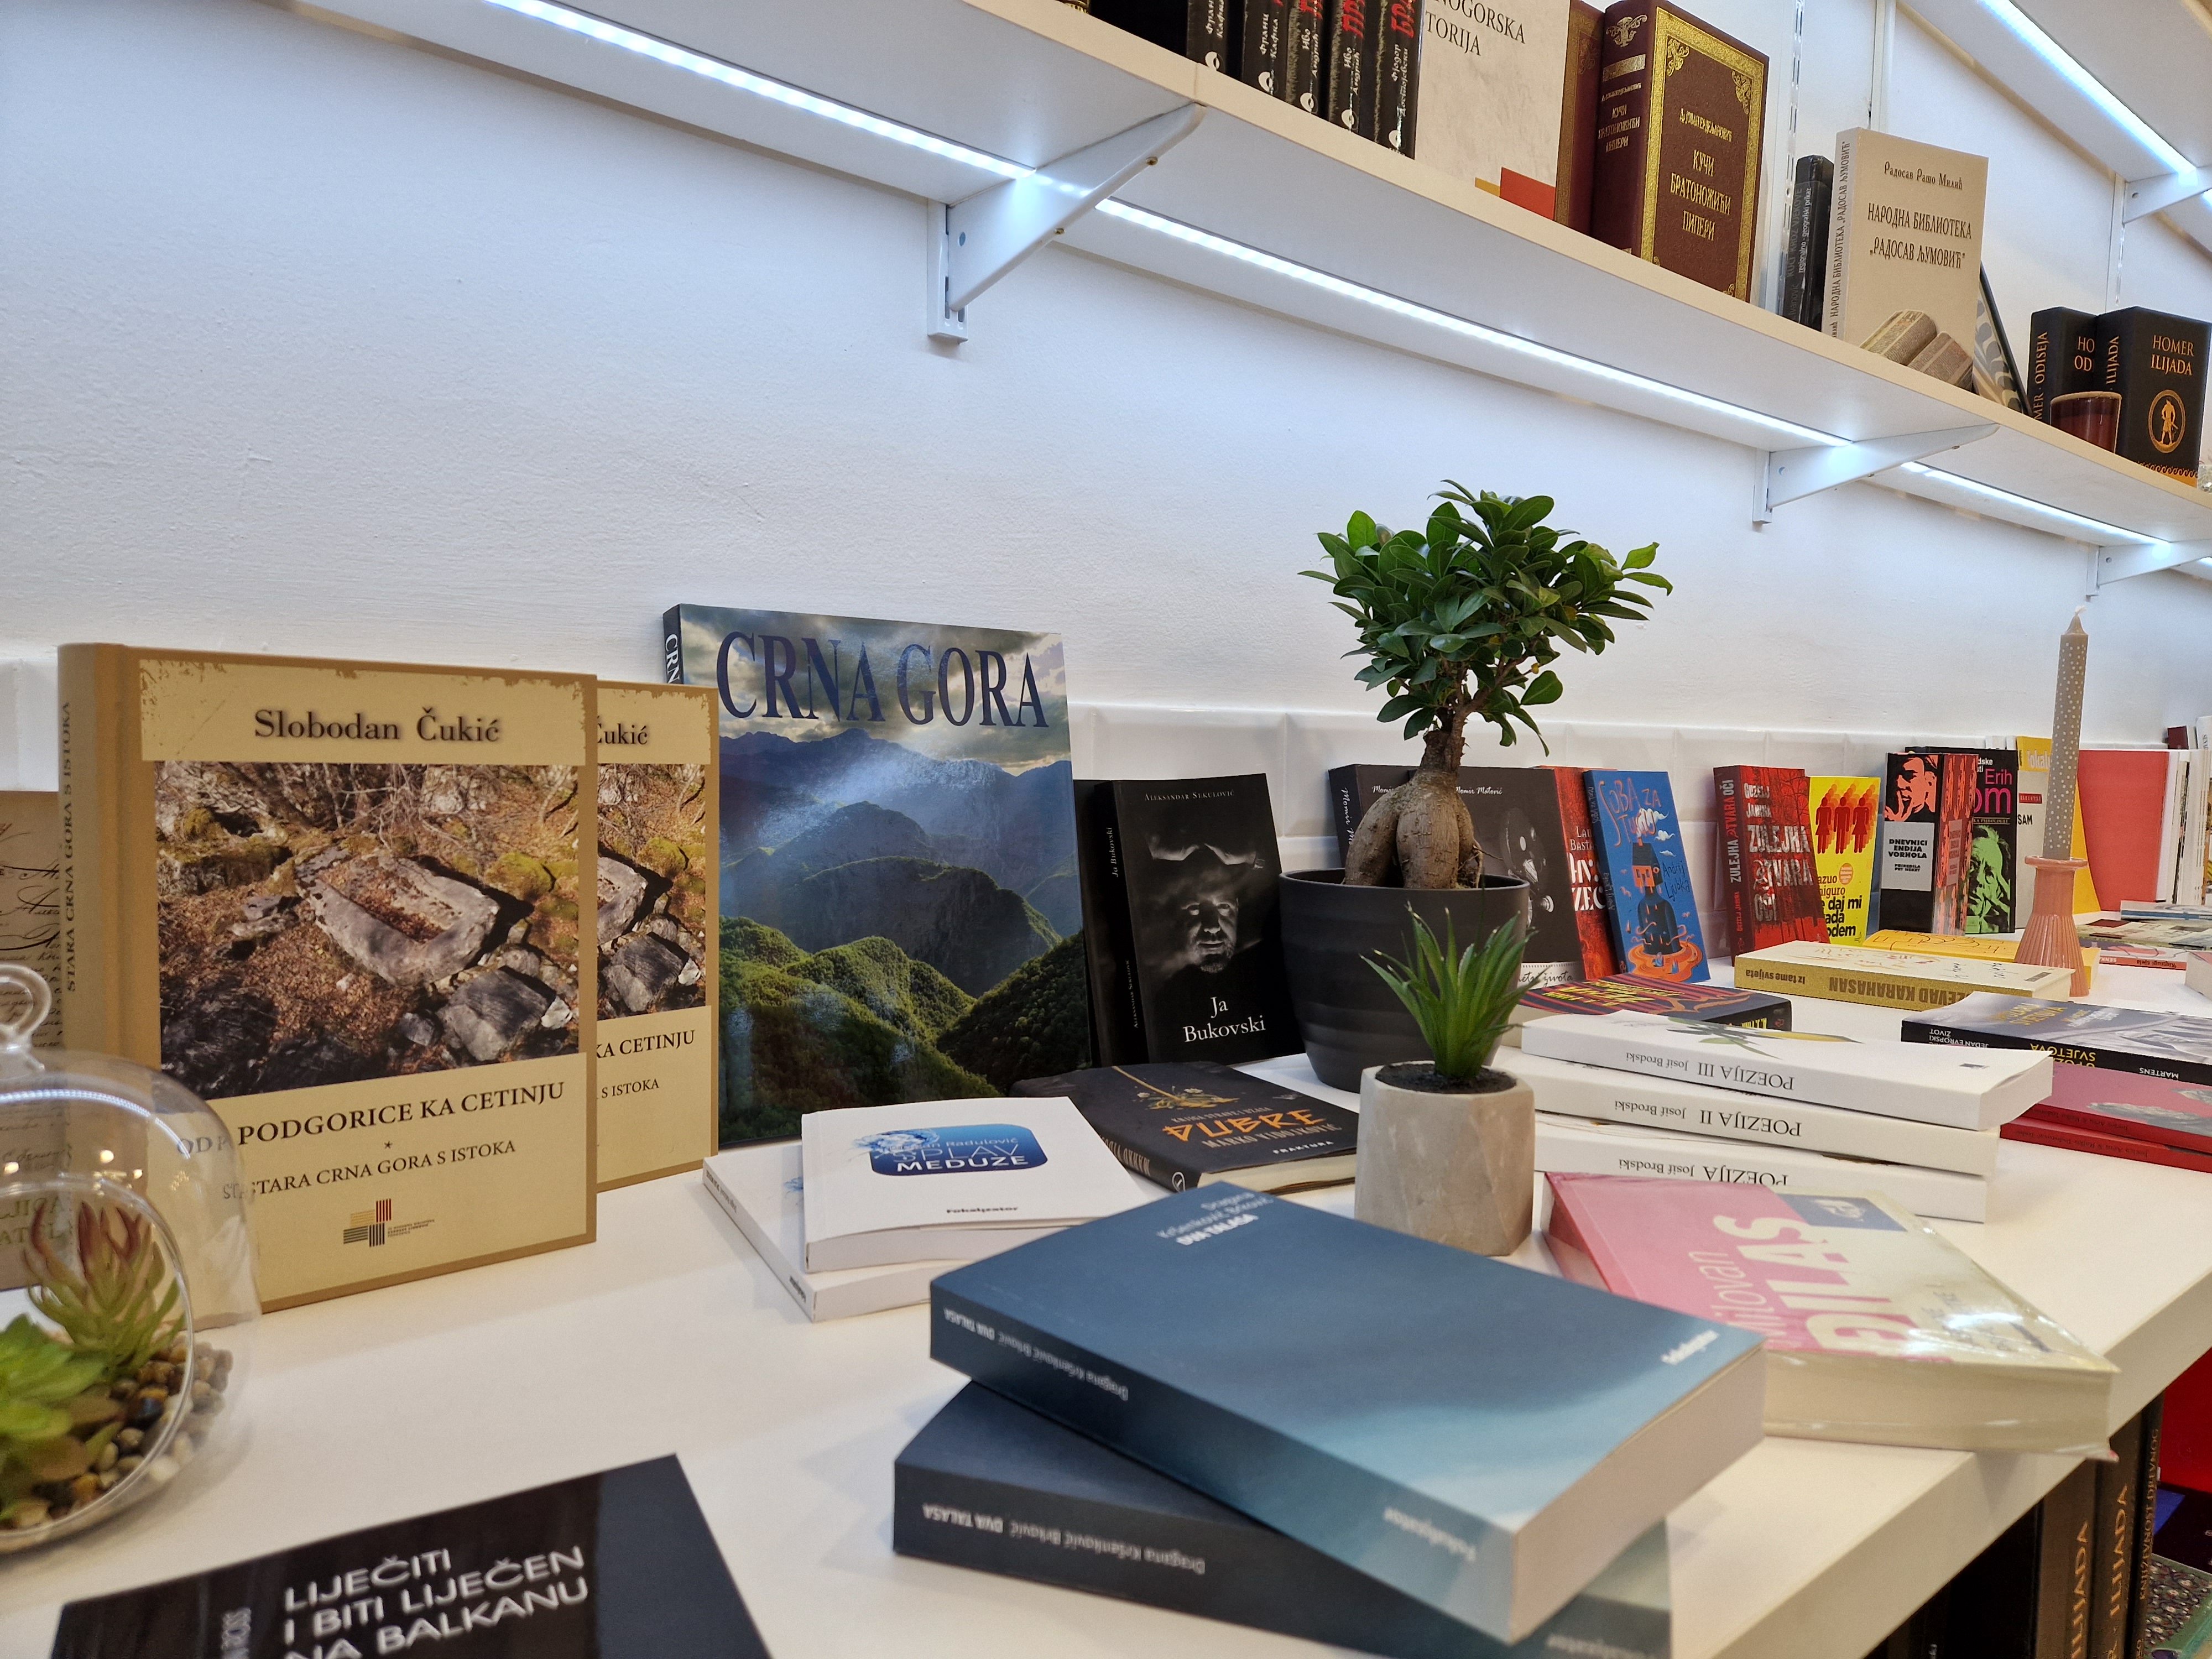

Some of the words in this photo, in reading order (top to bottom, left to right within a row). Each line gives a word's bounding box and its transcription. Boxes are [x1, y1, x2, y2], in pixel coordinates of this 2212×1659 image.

[1205, 0, 1215, 34] Фран
[1434, 0, 1526, 44] OGORSKA
[1259, 13, 1270, 55] Франц
[1270, 18, 1279, 59] Кафка
[1301, 28, 1311, 50] Иво
[1311, 33, 1320, 79] Андрић
[1343, 46, 1353, 69] Иво
[1391, 44, 1402, 81] Фјодор
[1693, 149, 1714, 178] КУЧИ
[1884, 161, 1913, 180] Радосав
[1916, 168, 1936, 185] Рашо
[1938, 173, 1963, 191] Милић
[1670, 173, 1732, 216] БРАТОНОЖИЋИ
[1682, 210, 1715, 241] ПИПЕРИ
[1867, 202, 1911, 228] НАРОДНА
[1913, 214, 1972, 240] БИБЛИОТЕКА
[1797, 241, 1807, 274] regionalno
[1802, 206, 1811, 237] geografski
[1834, 226, 1845, 279] БИБЛИОТЕКА
[1830, 280, 1841, 319] НАРОДНА
[2035, 332, 2048, 383] ODISEJA
[2152, 335, 2194, 357] HOMER
[2106, 336, 2120, 384] ILIJADA
[2151, 354, 2193, 376] ILIJADA
[2034, 395, 2044, 421] MER
[664, 633, 681, 684] CRN
[716, 630, 886, 722] CRNA
[896, 643, 1049, 728] GORA
[254, 709, 400, 742] Slobodan
[416, 707, 501, 742] Čukić
[61, 702, 71, 777] ISTOKA
[1723, 779, 1734, 796] OČI
[1985, 768, 2013, 785] Erih
[63, 784, 72, 796] S
[1372, 785, 1395, 794] Momi
[1641, 788, 1662, 808] ZA
[62, 818, 74, 860] GORA
[1106, 827, 1118, 865] Bukovski
[1747, 825, 1812, 853] ZULEJHA
[1727, 839, 1742, 883] ZULEJHA
[1888, 851, 1928, 859] VORHOLA
[1112, 865, 1119, 878] Ja
[1662, 860, 1686, 875] Andrij
[1818, 875, 1838, 884] azuo
[64, 875, 76, 921] CRNA
[1664, 878, 1691, 901] Ljubka
[1828, 896, 1845, 912] daj
[1848, 895, 1863, 909] mi
[1825, 910, 1845, 924] ada
[64, 940, 76, 993] STARA
[1745, 969, 1774, 982] svijeta
[1775, 973, 1796, 983] tame
[1796, 975, 1806, 984] Iz
[1829, 976, 1916, 1001] KARAHASAN
[1211, 996, 1229, 1019] Ja
[1182, 1015, 1267, 1042] Bukovski
[1929, 1029, 1952, 1039] ŽIVOT
[619, 1030, 696, 1056] CETINJU
[1929, 1035, 1964, 1047] EVROPSKI
[1965, 1040, 1989, 1048] JEDAN
[1626, 1052, 1664, 1068] Brodski
[1666, 1057, 1689, 1072] Josif
[1698, 1062, 1715, 1078] III
[1720, 1065, 1795, 1091] POEZIJA
[2139, 1067, 2179, 1079] MARTENS
[601, 1087, 608, 1098] S
[611, 1078, 660, 1097] ISTOKA
[238, 1103, 414, 1146] PODGORICE
[420, 1099, 455, 1119] KA
[461, 1081, 566, 1113] CETINJU
[1614, 1100, 1658, 1115] Brodski
[1660, 1105, 1686, 1120] Josif
[1699, 1109, 1712, 1125] II
[1162, 1108, 1327, 1142] ĐUBRE
[1719, 1112, 1802, 1138] POEZIJA
[893, 1144, 1019, 1163] SPLAV
[946, 1138, 1019, 1147] Radulović
[1202, 1135, 1255, 1149] MARKO
[1273, 1140, 1334, 1155] FRAKTURA
[316, 1164, 372, 1185] CRNA
[377, 1152, 433, 1173] GORA
[437, 1150, 446, 1165] S
[451, 1140, 516, 1162] ISTOKA
[896, 1155, 1029, 1172] MEDUZE
[1618, 1158, 1665, 1174] Brodski
[1667, 1164, 1694, 1178] Josif
[284, 1548, 452, 1612] LIJEČITI
[284, 1618, 295, 1646] I
[313, 1596, 385, 1637] BITI
[401, 1545, 585, 1614] LIJEČEN
[376, 1576, 589, 1655] BALKANU
